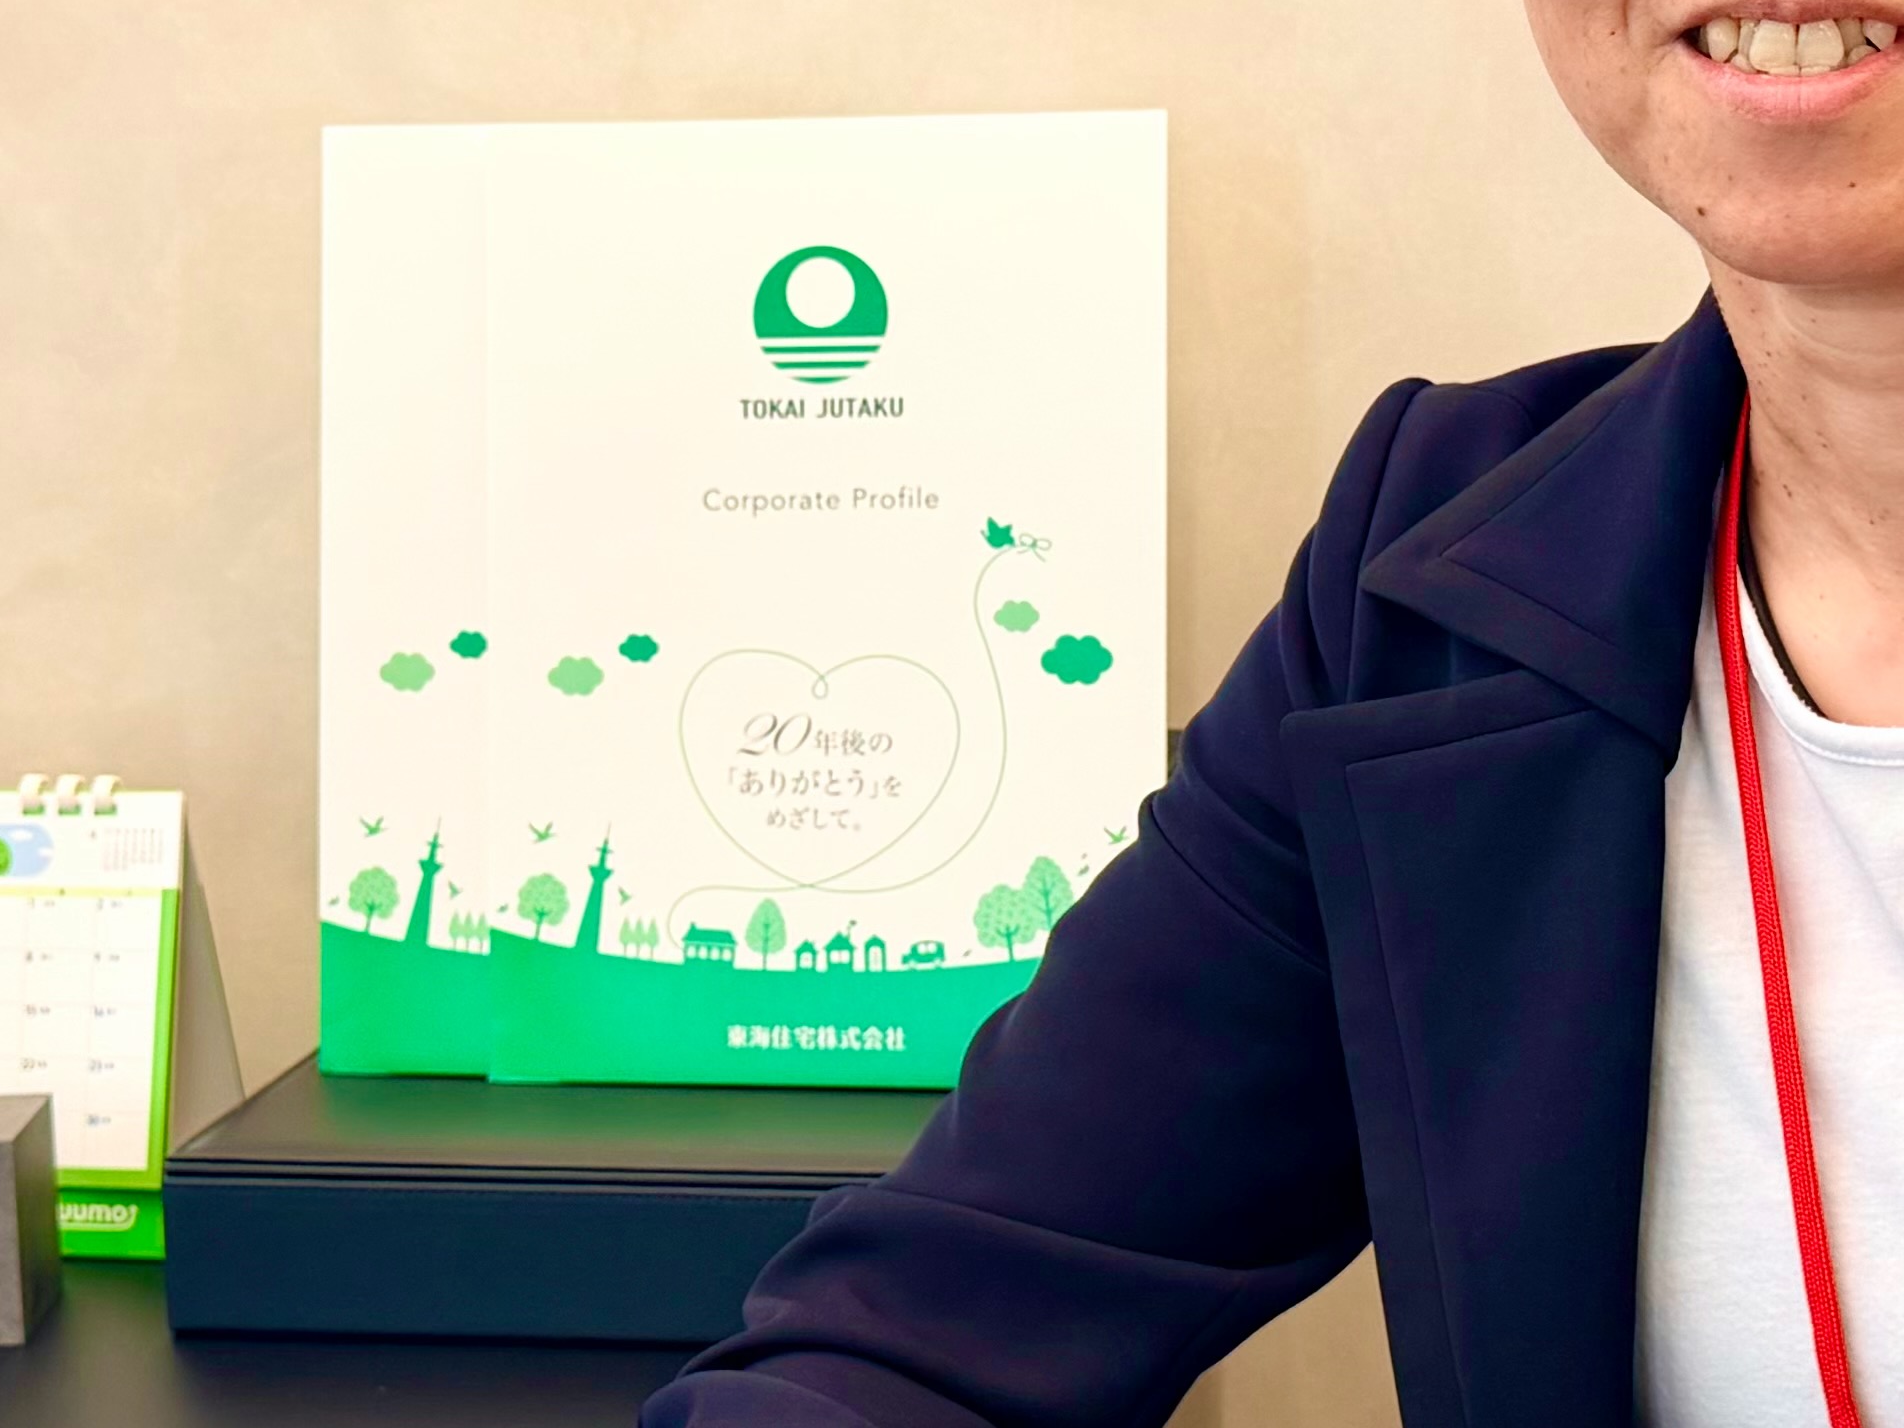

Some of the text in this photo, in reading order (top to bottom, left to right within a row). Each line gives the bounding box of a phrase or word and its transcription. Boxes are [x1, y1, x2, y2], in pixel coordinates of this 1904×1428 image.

[739, 396, 905, 420] TOKAI JUTAKU
[702, 485, 940, 518] Corporate Profile
[736, 712, 893, 756] 20年後の
[728, 766, 902, 799] 「ありがとう」を
[767, 807, 861, 832] めざして。
[727, 1024, 907, 1052] 東海住宅株式会社
[58, 1203, 133, 1228] uumo
